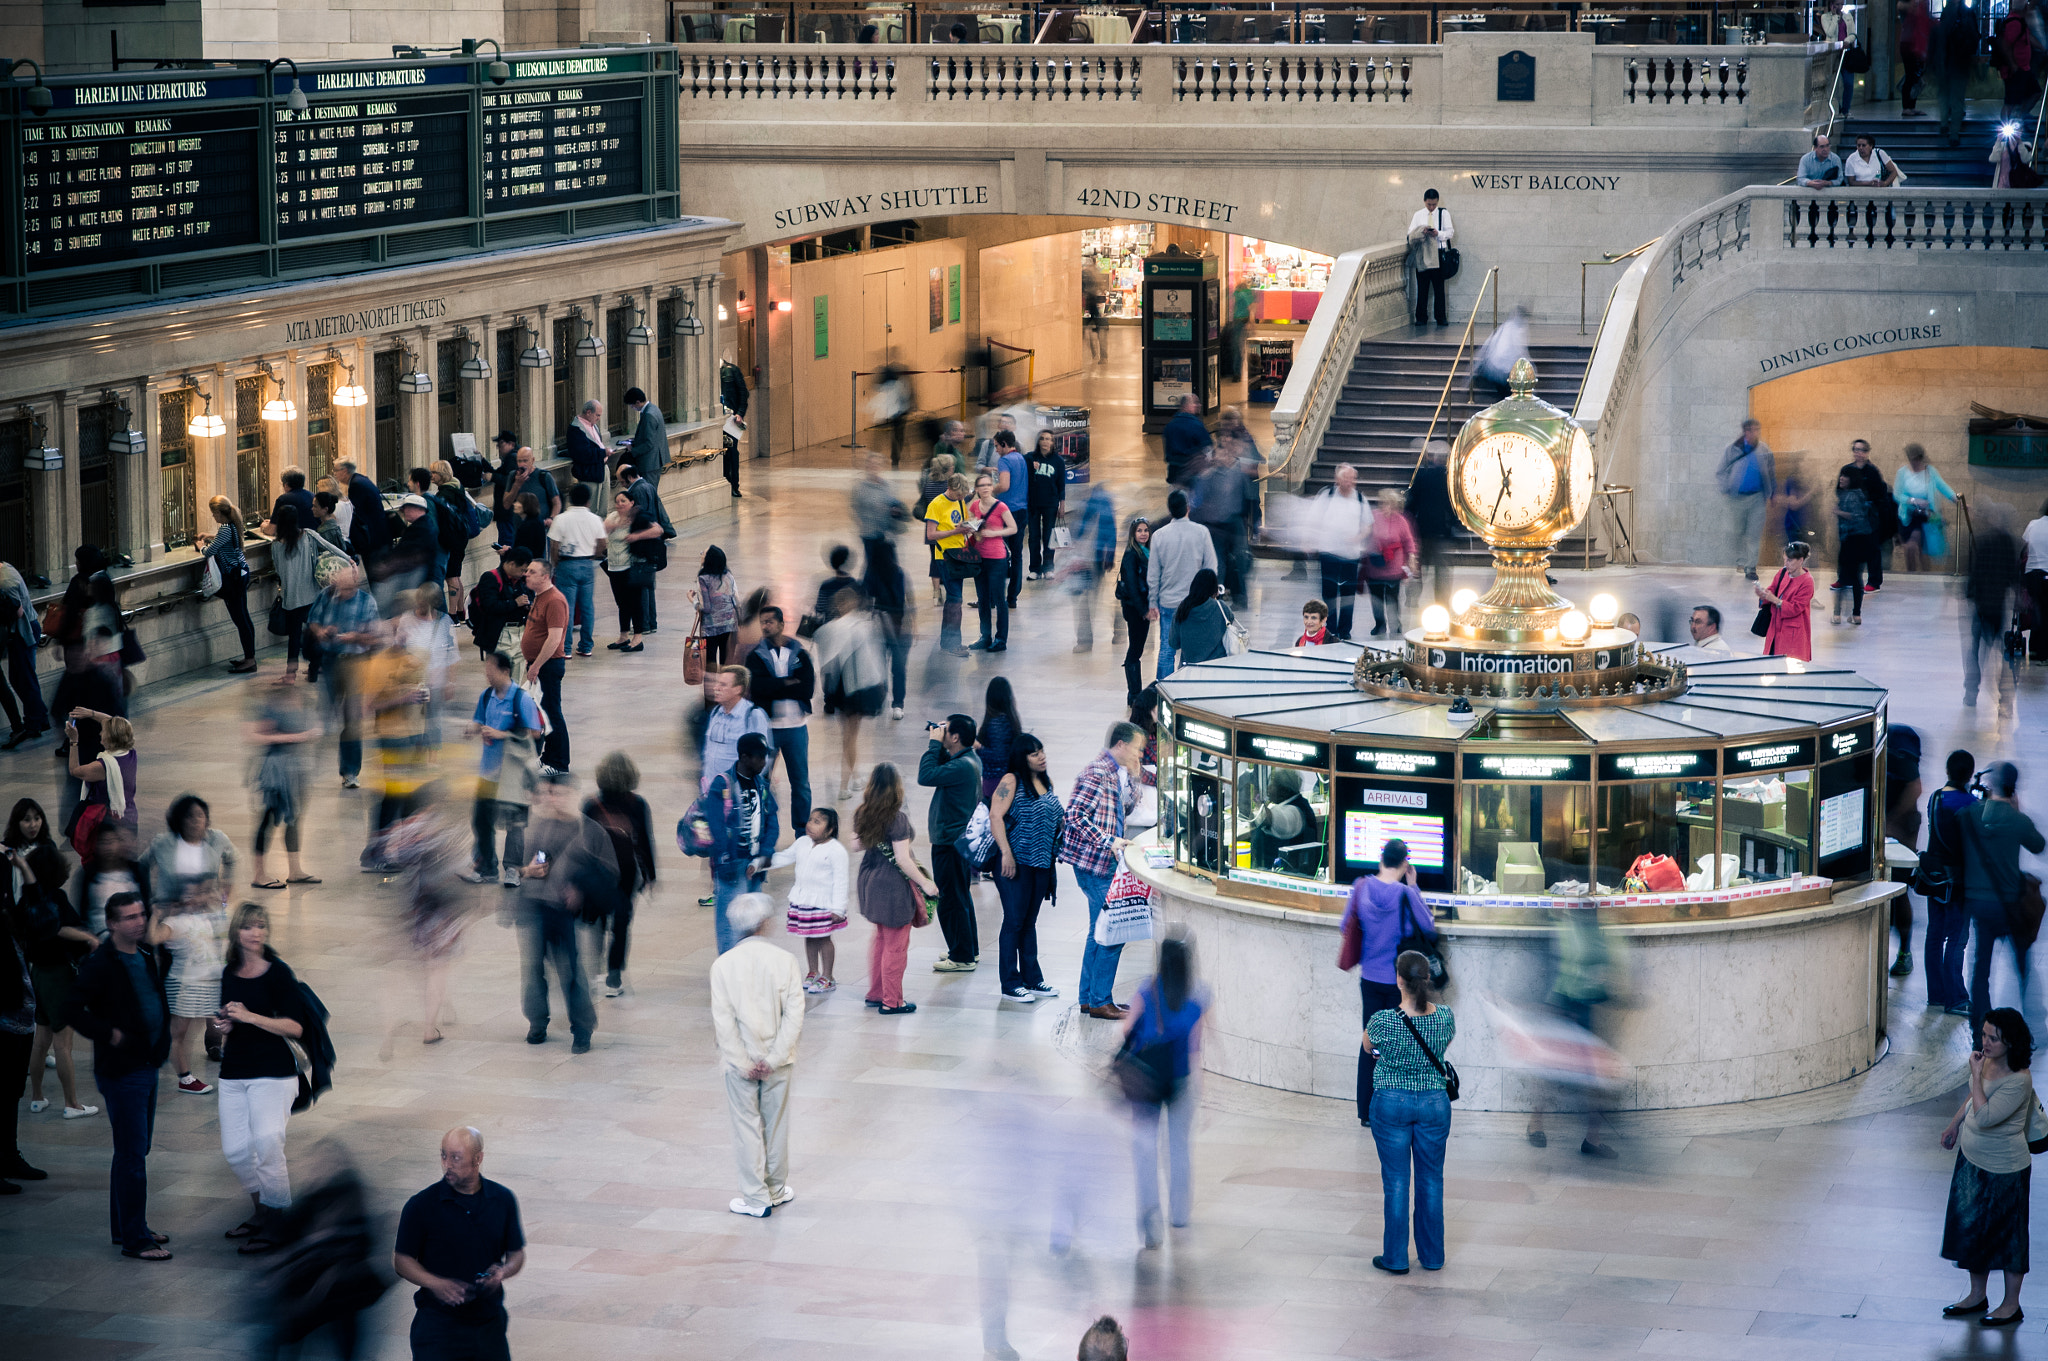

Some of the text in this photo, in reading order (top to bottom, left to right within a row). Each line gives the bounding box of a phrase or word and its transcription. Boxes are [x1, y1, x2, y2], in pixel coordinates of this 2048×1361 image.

[516, 57, 608, 78] HUDSON LINE DEPARTURES
[317, 68, 426, 90] HARLEM LINE DEPARTURES
[75, 80, 207, 105] HARLEM LINE DEPARTURES
[482, 88, 583, 107] TIME TRK DESTINATION REMARKS
[275, 101, 398, 122] TIME DESTINATION REMARKS
[23, 118, 172, 141] TIME TRK DESTINATION REMARKS
[66, 146, 99, 161] SOUTHEAST
[130, 141, 166, 156] CONNECTION
[168, 140, 176, 153] TO
[49, 172, 60, 185] 112
[78, 168, 97, 182] WHITE
[99, 166, 121, 180] PLAINS
[165, 161, 176, 175] 1ST
[178, 159, 193, 173] STOP
[1470, 174, 1622, 191] WEST BALCONY
[67, 189, 101, 206] SOUTHEAST
[131, 183, 163, 199] SCARSDALE
[172, 181, 183, 195] 1ST
[185, 180, 200, 194] STOP
[79, 212, 98, 226] WHITE
[100, 209, 123, 224] PLAINS
[131, 205, 157, 221] FORDHAM
[166, 203, 177, 217] 1ST
[179, 201, 194, 215] STOP
[774, 185, 989, 230] SUBWAY SHUTTLE
[1076, 187, 1239, 224] 42ND STREET
[68, 233, 102, 250] SOUTHEAST
[132, 227, 151, 242] WHITE
[152, 225, 175, 240] PLAINS
[183, 222, 194, 236] 1ST
[196, 220, 211, 235] STOP
[285, 297, 446, 343] MTA METRO-NORTH TICKETS
[1262, 346, 1291, 355] Welcom
[1759, 324, 1943, 373] DINING CONCOURSE
[1983, 438, 2048, 455] DININ
[1460, 651, 1573, 674] Information
[1355, 751, 1437, 766] MTA METRO-NORTH
[1737, 745, 1799, 761] MTA METRO-NORTH
[1750, 755, 1788, 767] TIMETABLES
[1375, 760, 1416, 772] ARRIVALS
[1367, 791, 1424, 806] ARRIVALS
